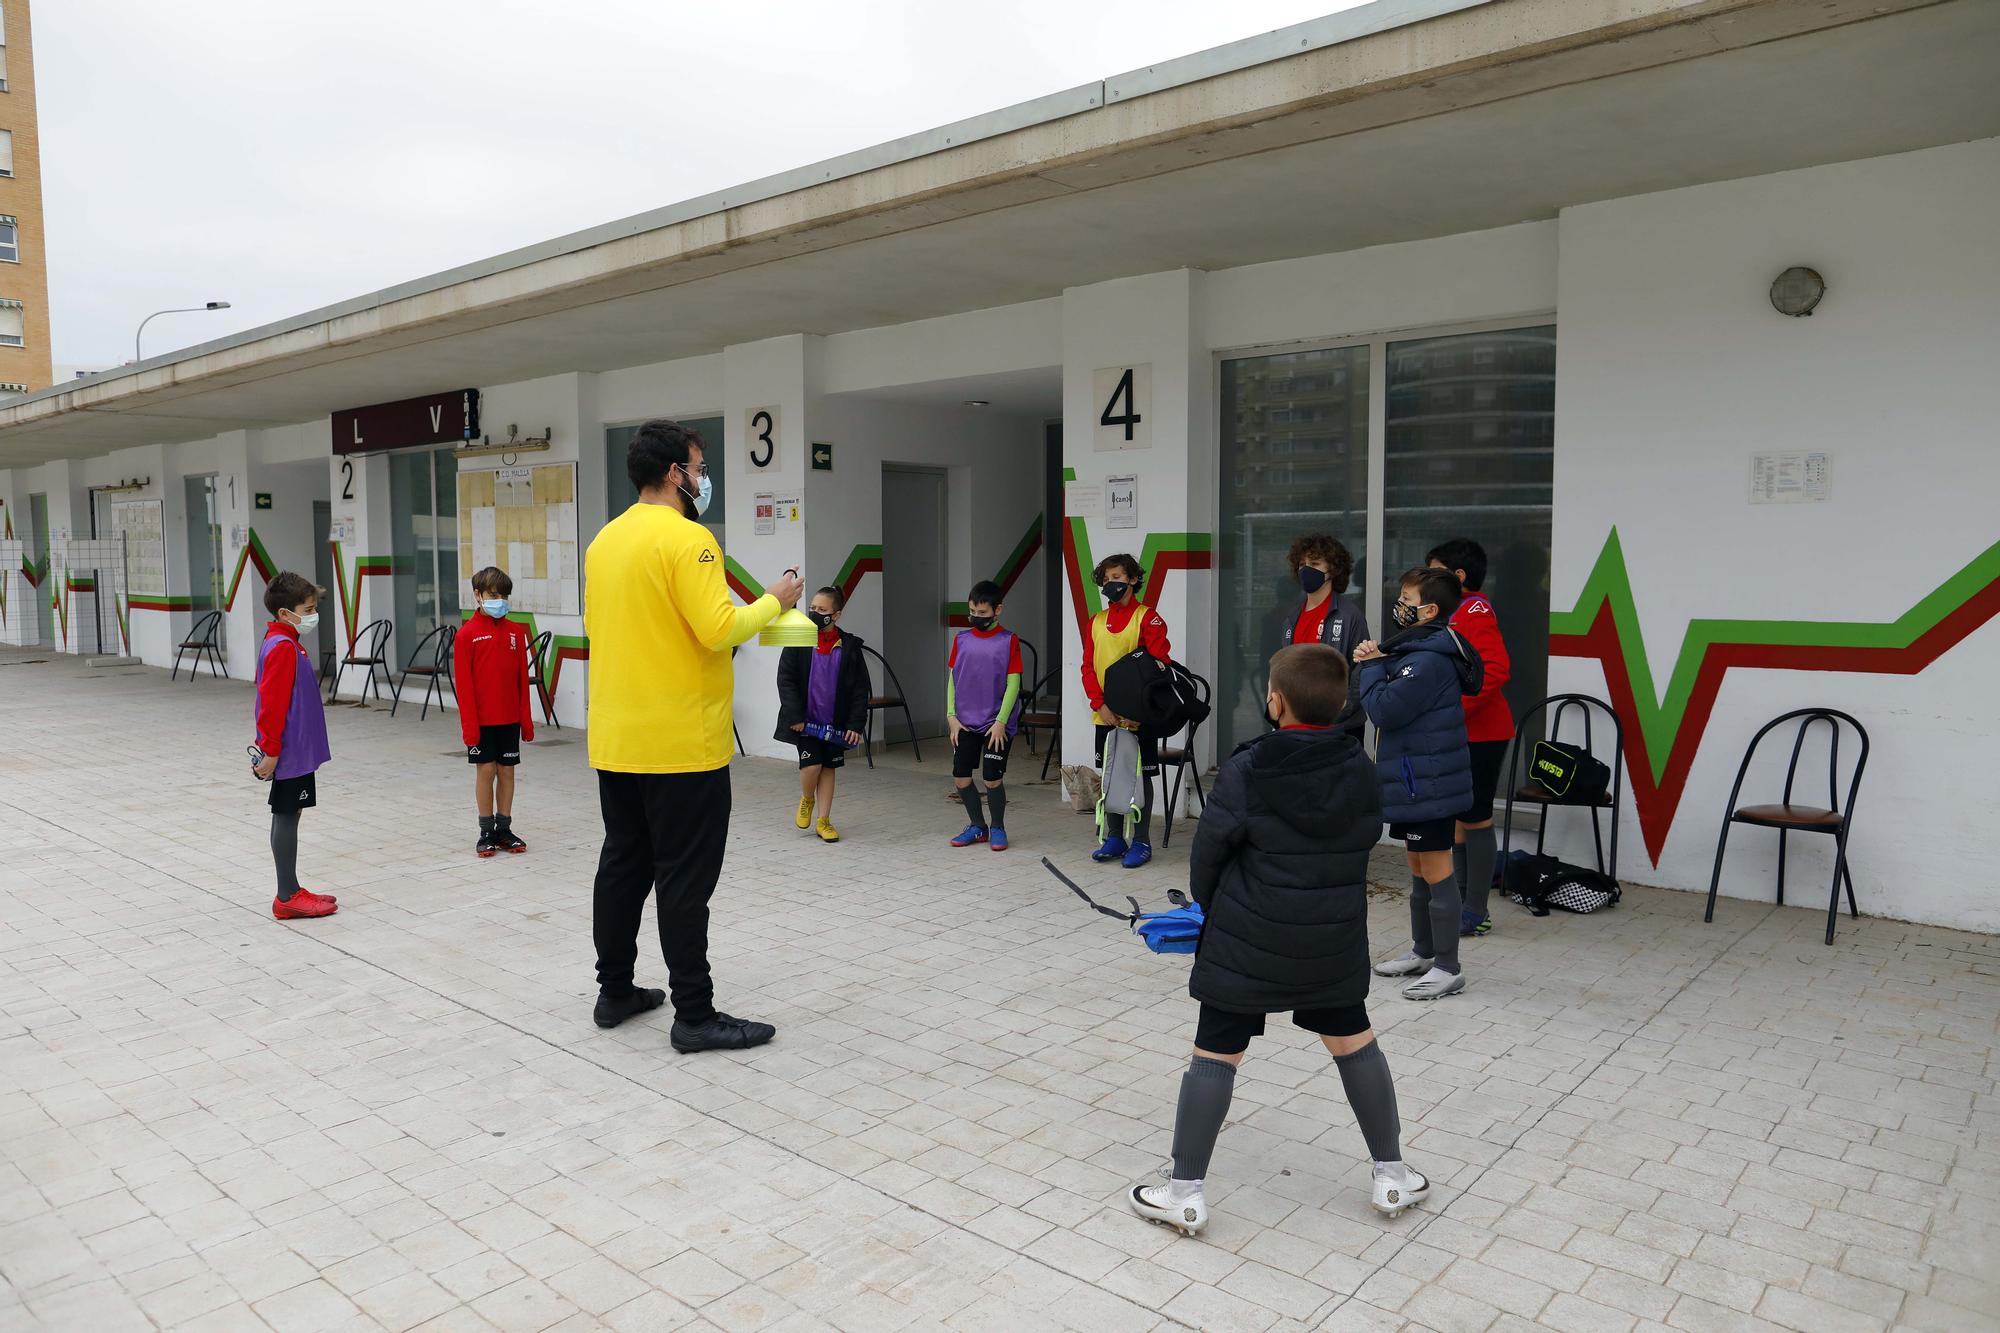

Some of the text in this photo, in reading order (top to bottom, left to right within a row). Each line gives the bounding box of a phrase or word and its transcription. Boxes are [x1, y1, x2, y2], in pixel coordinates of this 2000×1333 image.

[354, 418, 363, 444] L
[430, 404, 442, 433] V
[1101, 368, 1141, 441] 4
[749, 410, 774, 467] 3
[228, 475, 235, 510] 1
[341, 460, 354, 499] 2
